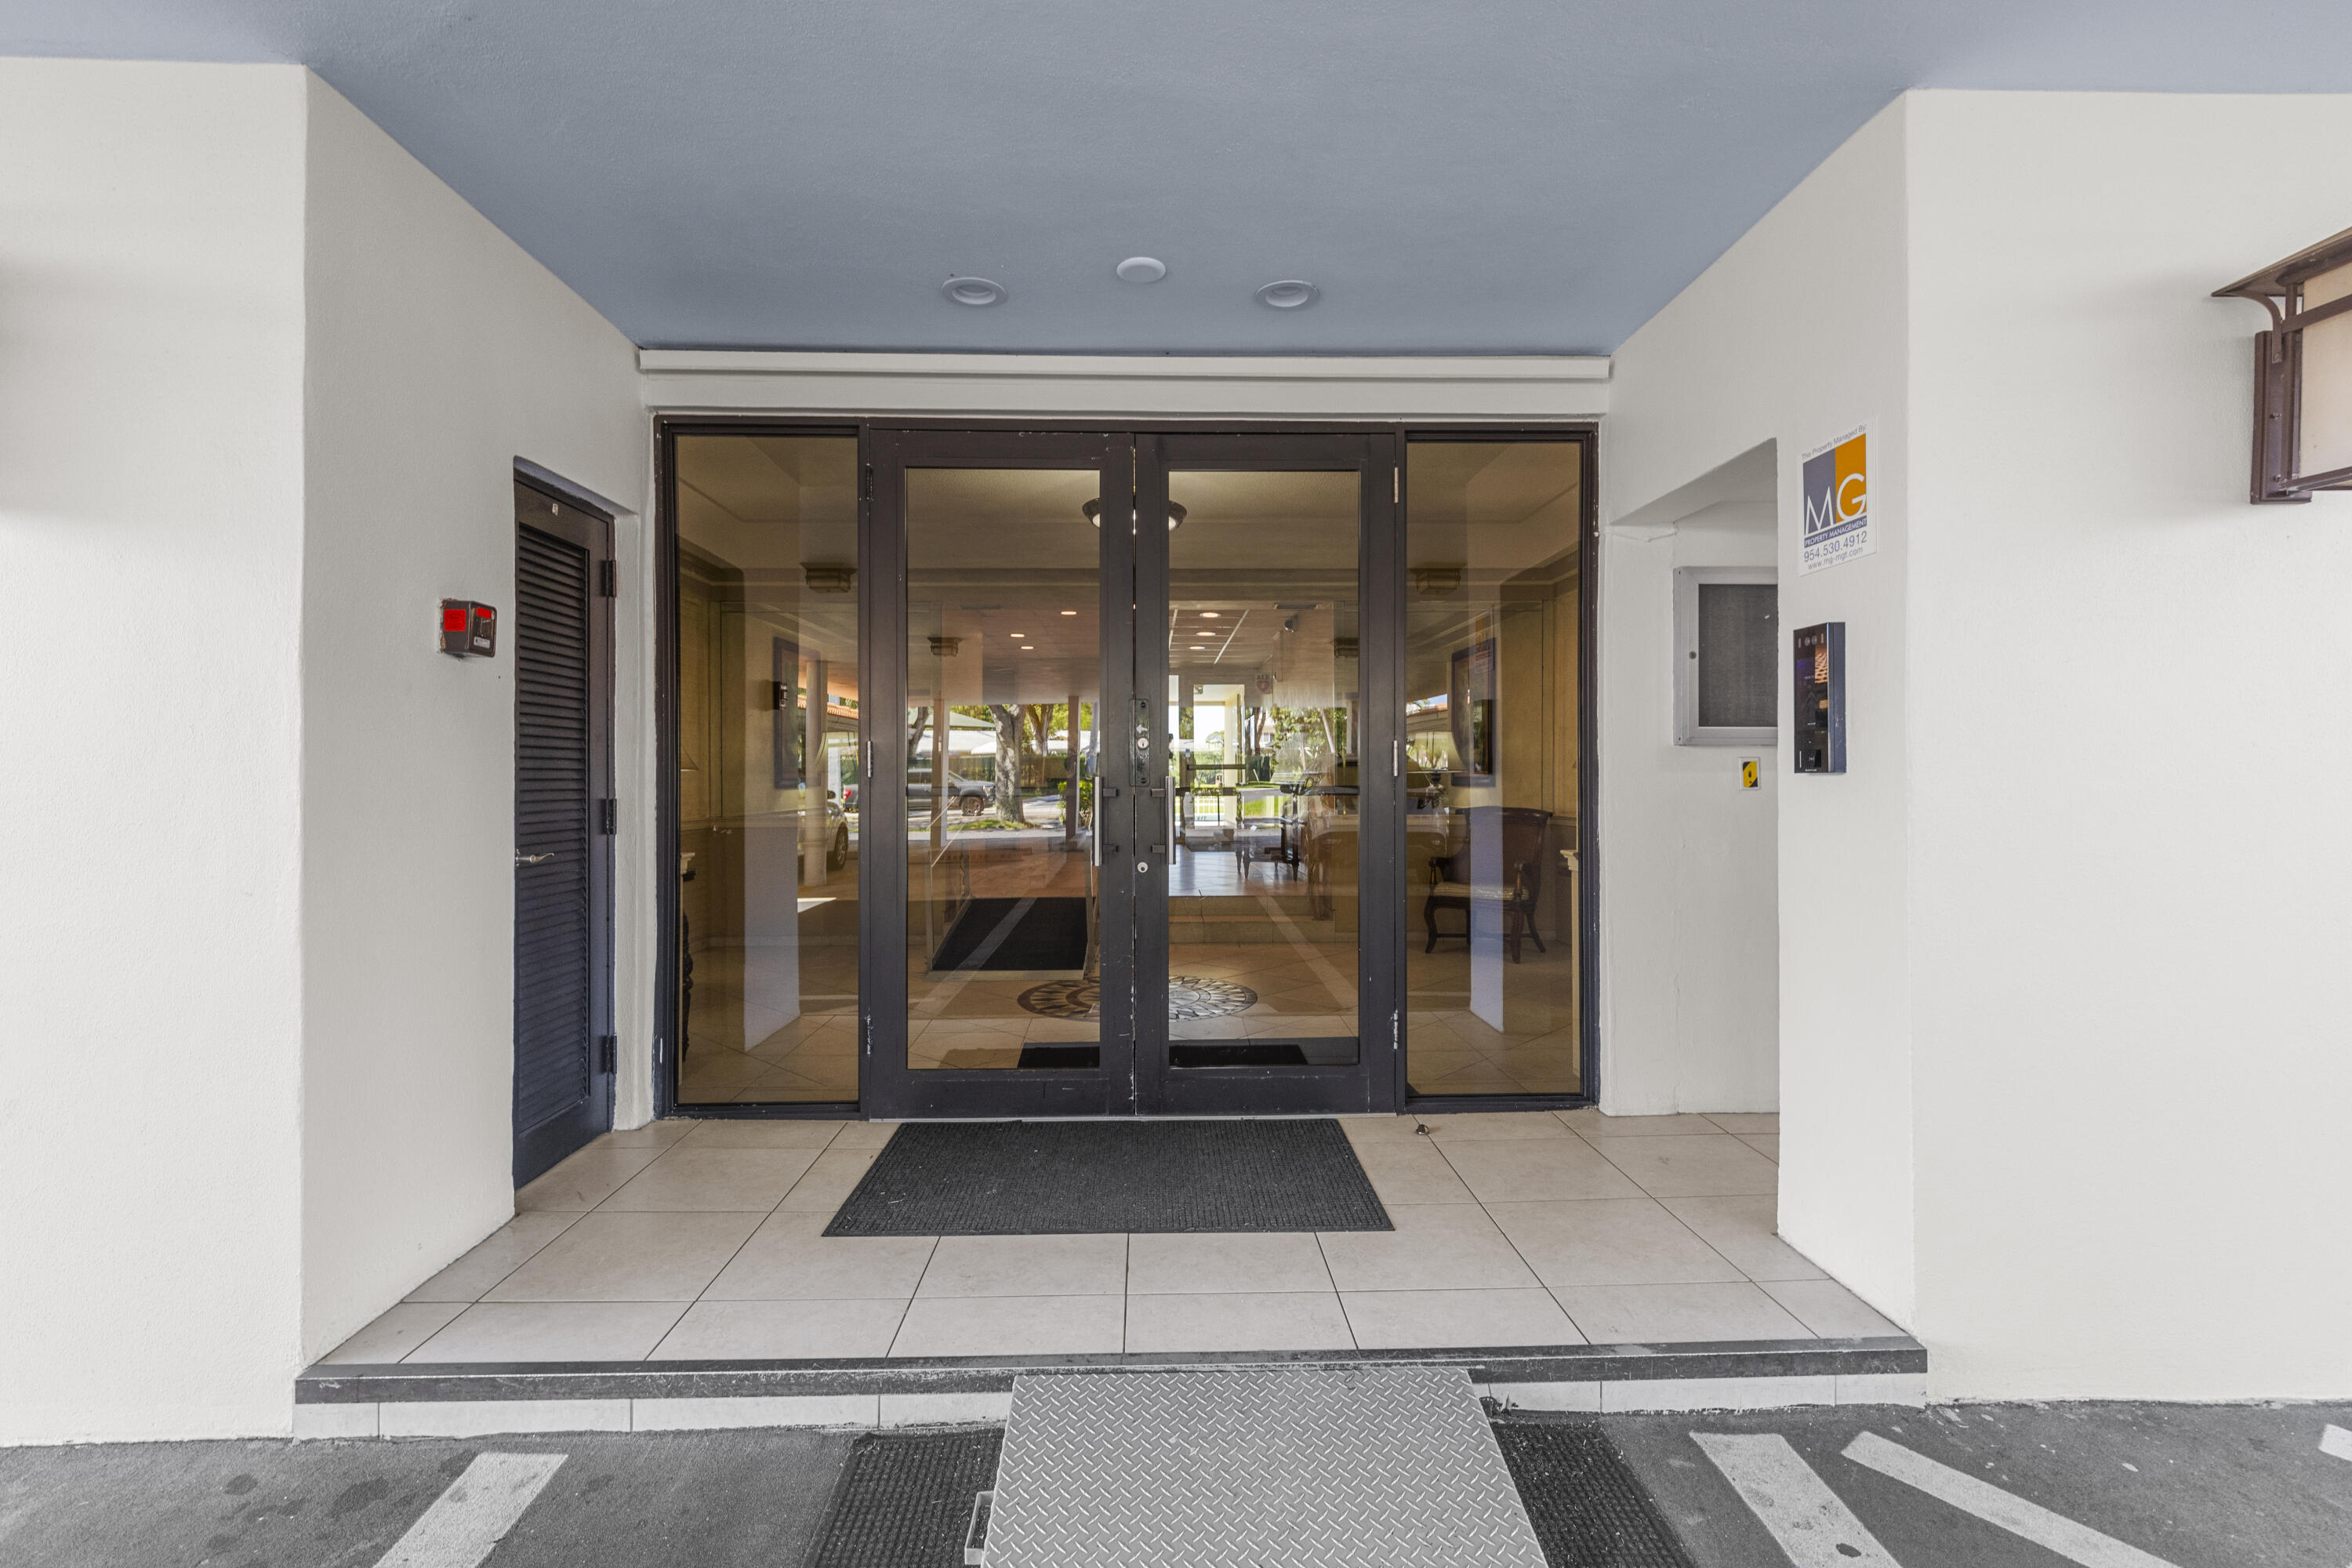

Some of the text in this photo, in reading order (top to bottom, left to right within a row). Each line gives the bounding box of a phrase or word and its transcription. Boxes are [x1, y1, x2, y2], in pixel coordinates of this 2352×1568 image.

[1802, 452, 1812, 461] This
[1812, 441, 1832, 455] Property
[1834, 428, 1857, 445] Managed
[1805, 473, 1867, 535] MG
[1804, 531, 1867, 562] 954.530.4912
[1805, 518, 1867, 547] PROPERTY MANAGEMENT
[1808, 546, 1864, 570] www.mg-mgt.com
